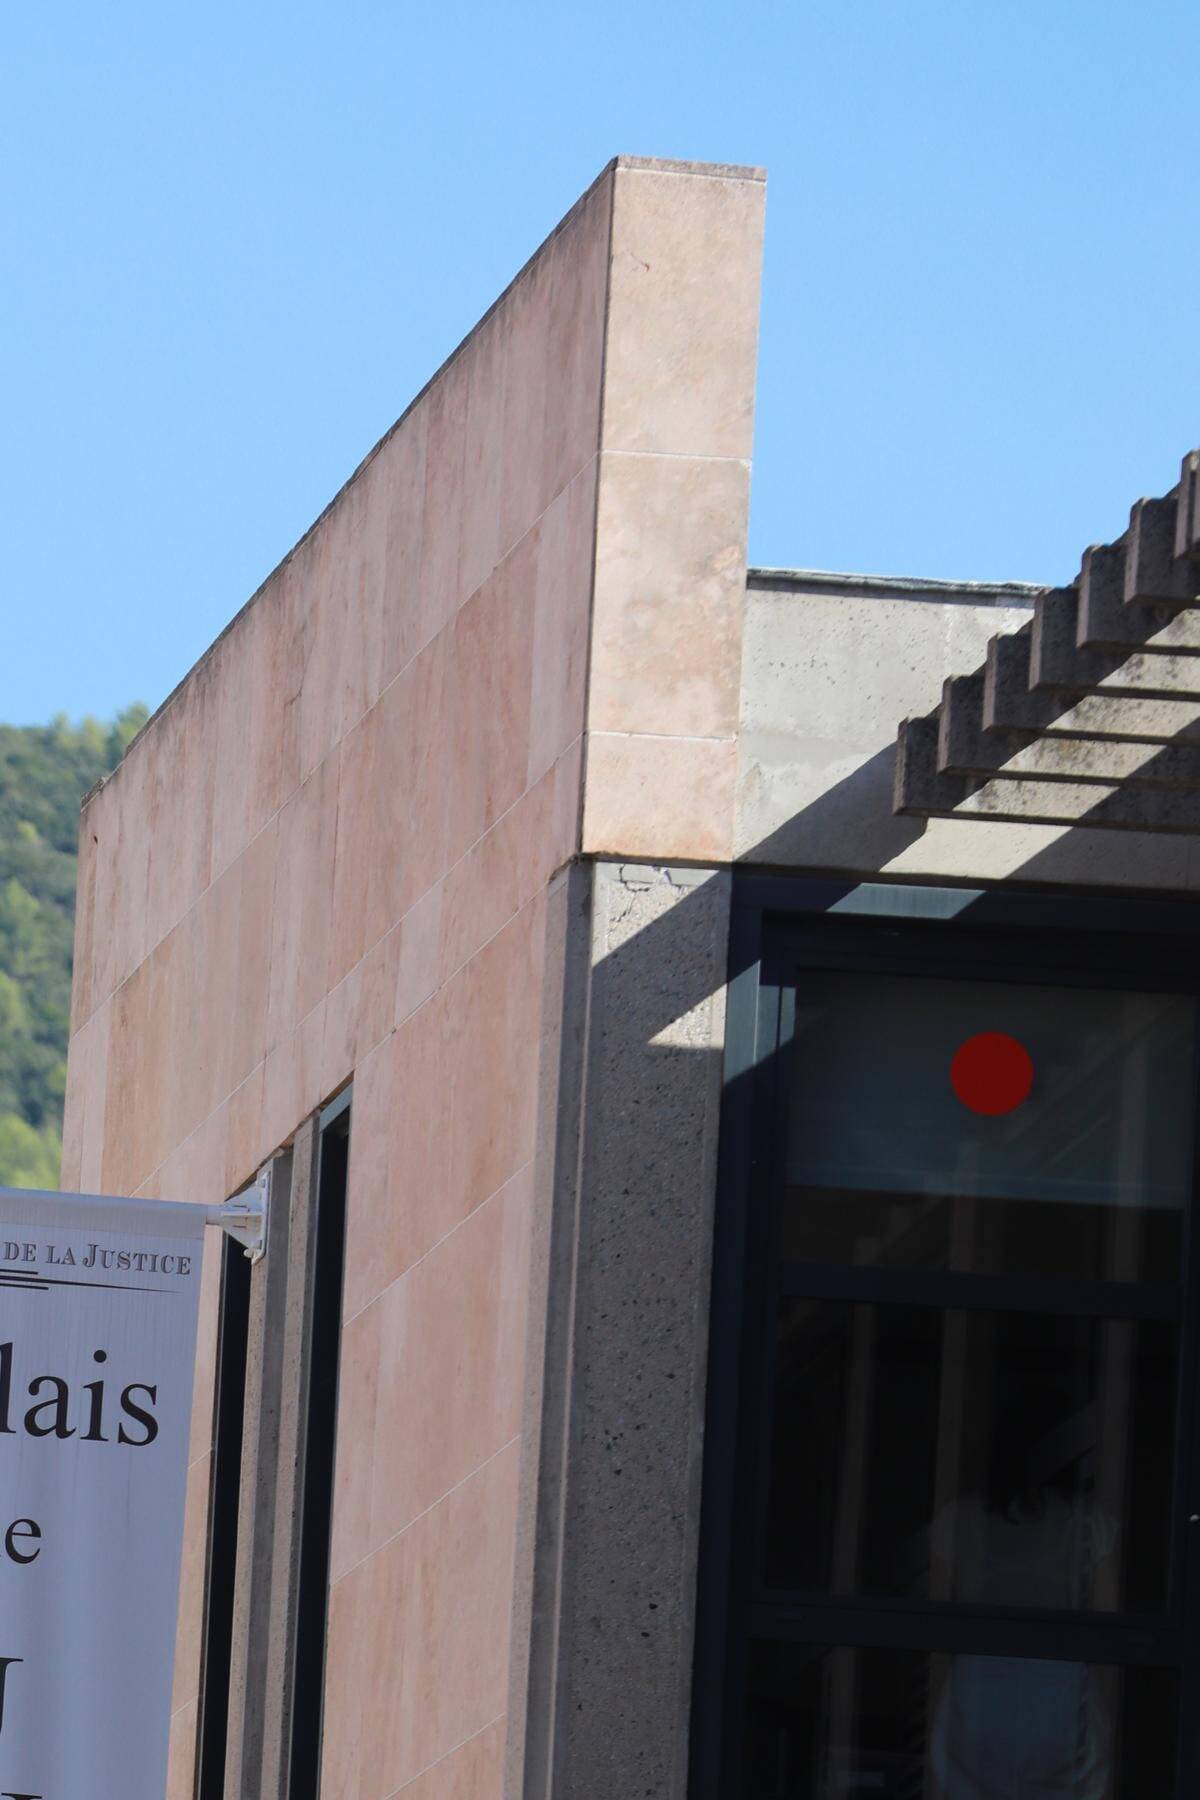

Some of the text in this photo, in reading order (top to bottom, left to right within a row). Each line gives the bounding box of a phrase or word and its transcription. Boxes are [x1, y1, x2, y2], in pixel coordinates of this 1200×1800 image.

[3, 1240, 37, 1262] DE
[45, 1245, 76, 1266] LA
[82, 1243, 191, 1276] JUSTICE
